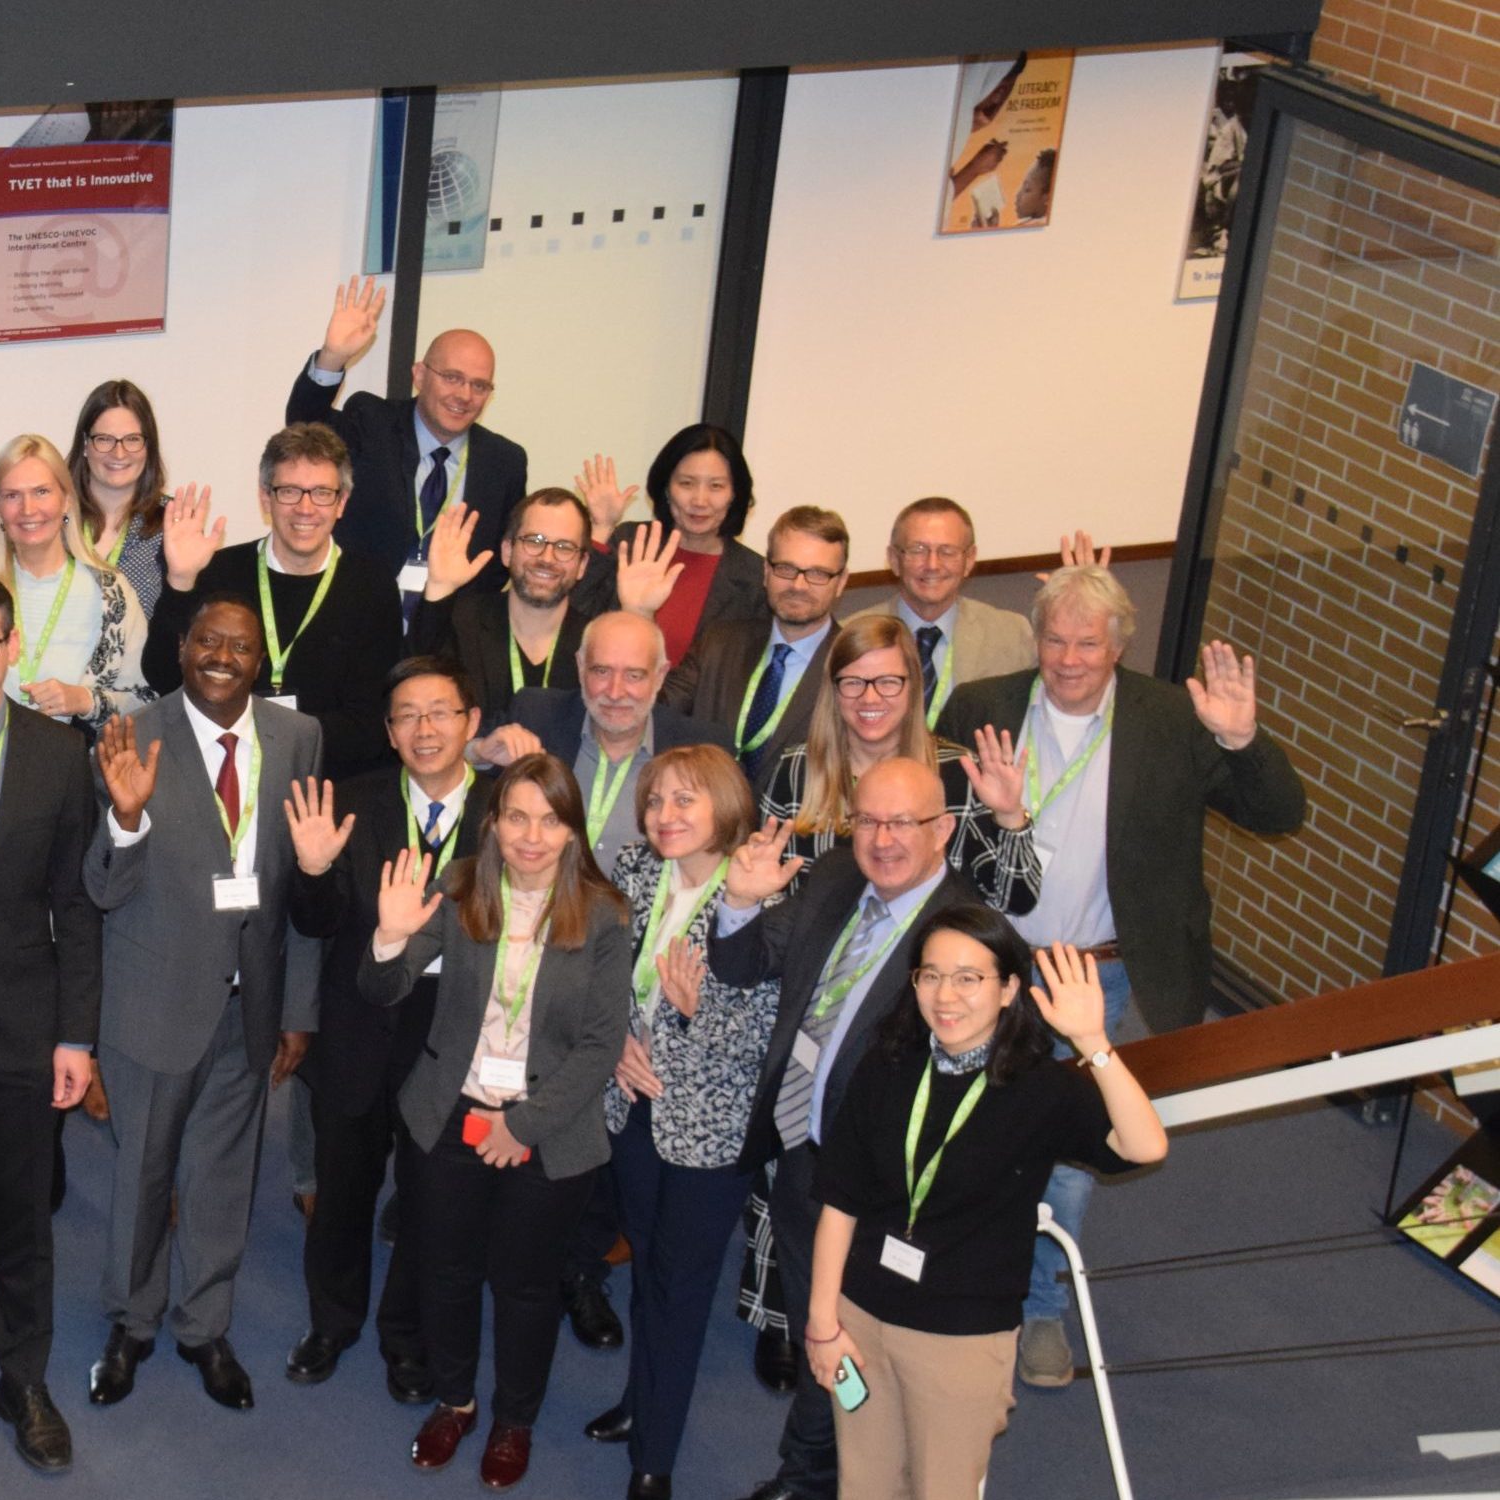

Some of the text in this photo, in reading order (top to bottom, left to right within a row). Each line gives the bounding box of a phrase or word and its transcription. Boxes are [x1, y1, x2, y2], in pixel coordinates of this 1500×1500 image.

[8, 177, 43, 191] TVET
[46, 176, 73, 189] that
[76, 174, 87, 187] is
[8, 228, 97, 241] The UNESCO-UNEVOC
[7, 240, 88, 252] International Centre
